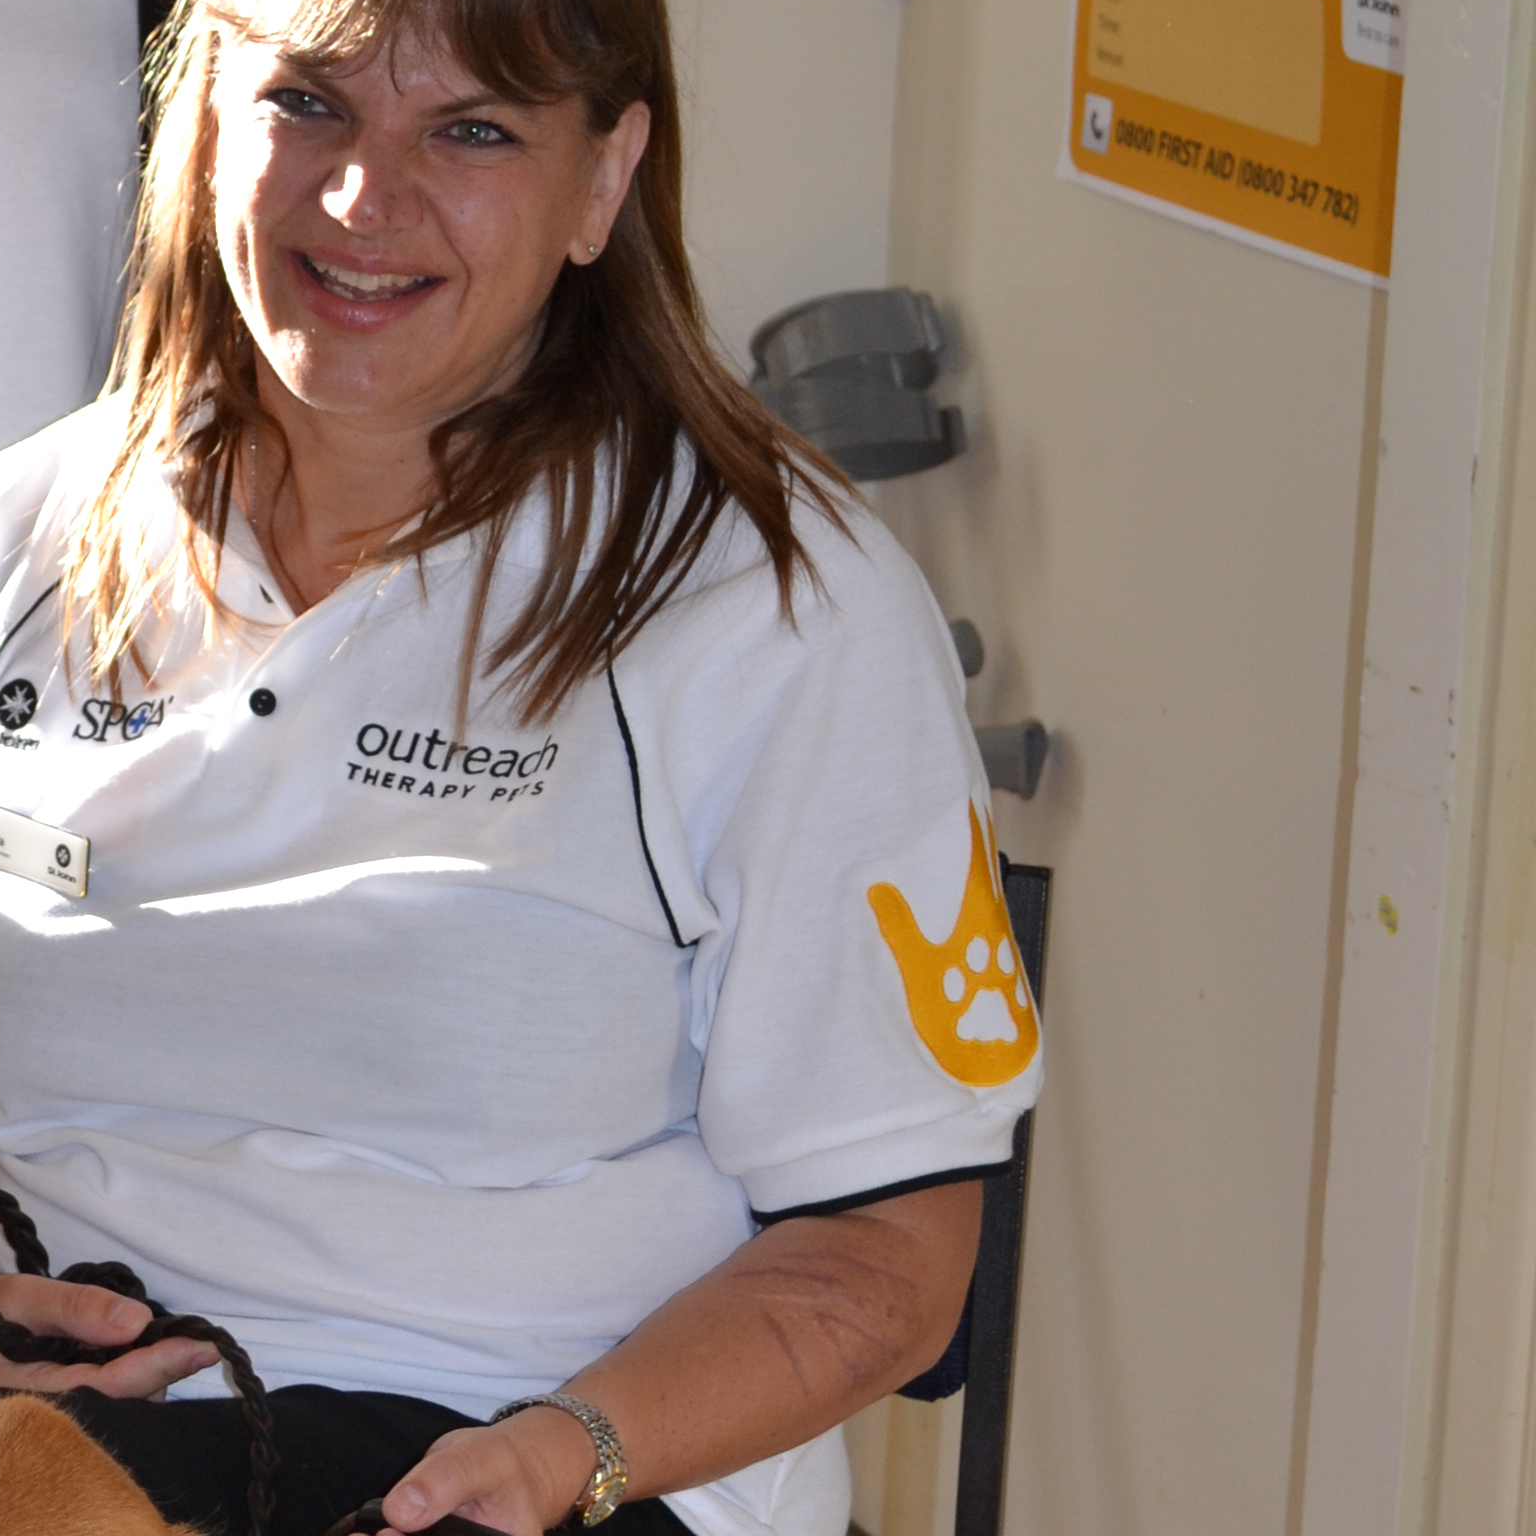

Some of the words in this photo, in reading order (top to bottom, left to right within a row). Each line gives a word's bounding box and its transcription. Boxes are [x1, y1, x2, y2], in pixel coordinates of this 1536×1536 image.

[1116, 119, 1155, 155] 0800
[1158, 131, 1203, 172] FIRST
[1203, 147, 1235, 181] AID
[1236, 157, 1285, 198] (0800
[1287, 175, 1320, 209] 347
[1322, 185, 1360, 226] 782)
[72, 697, 164, 743] SPCA
[346, 762, 476, 799] THERAPY
